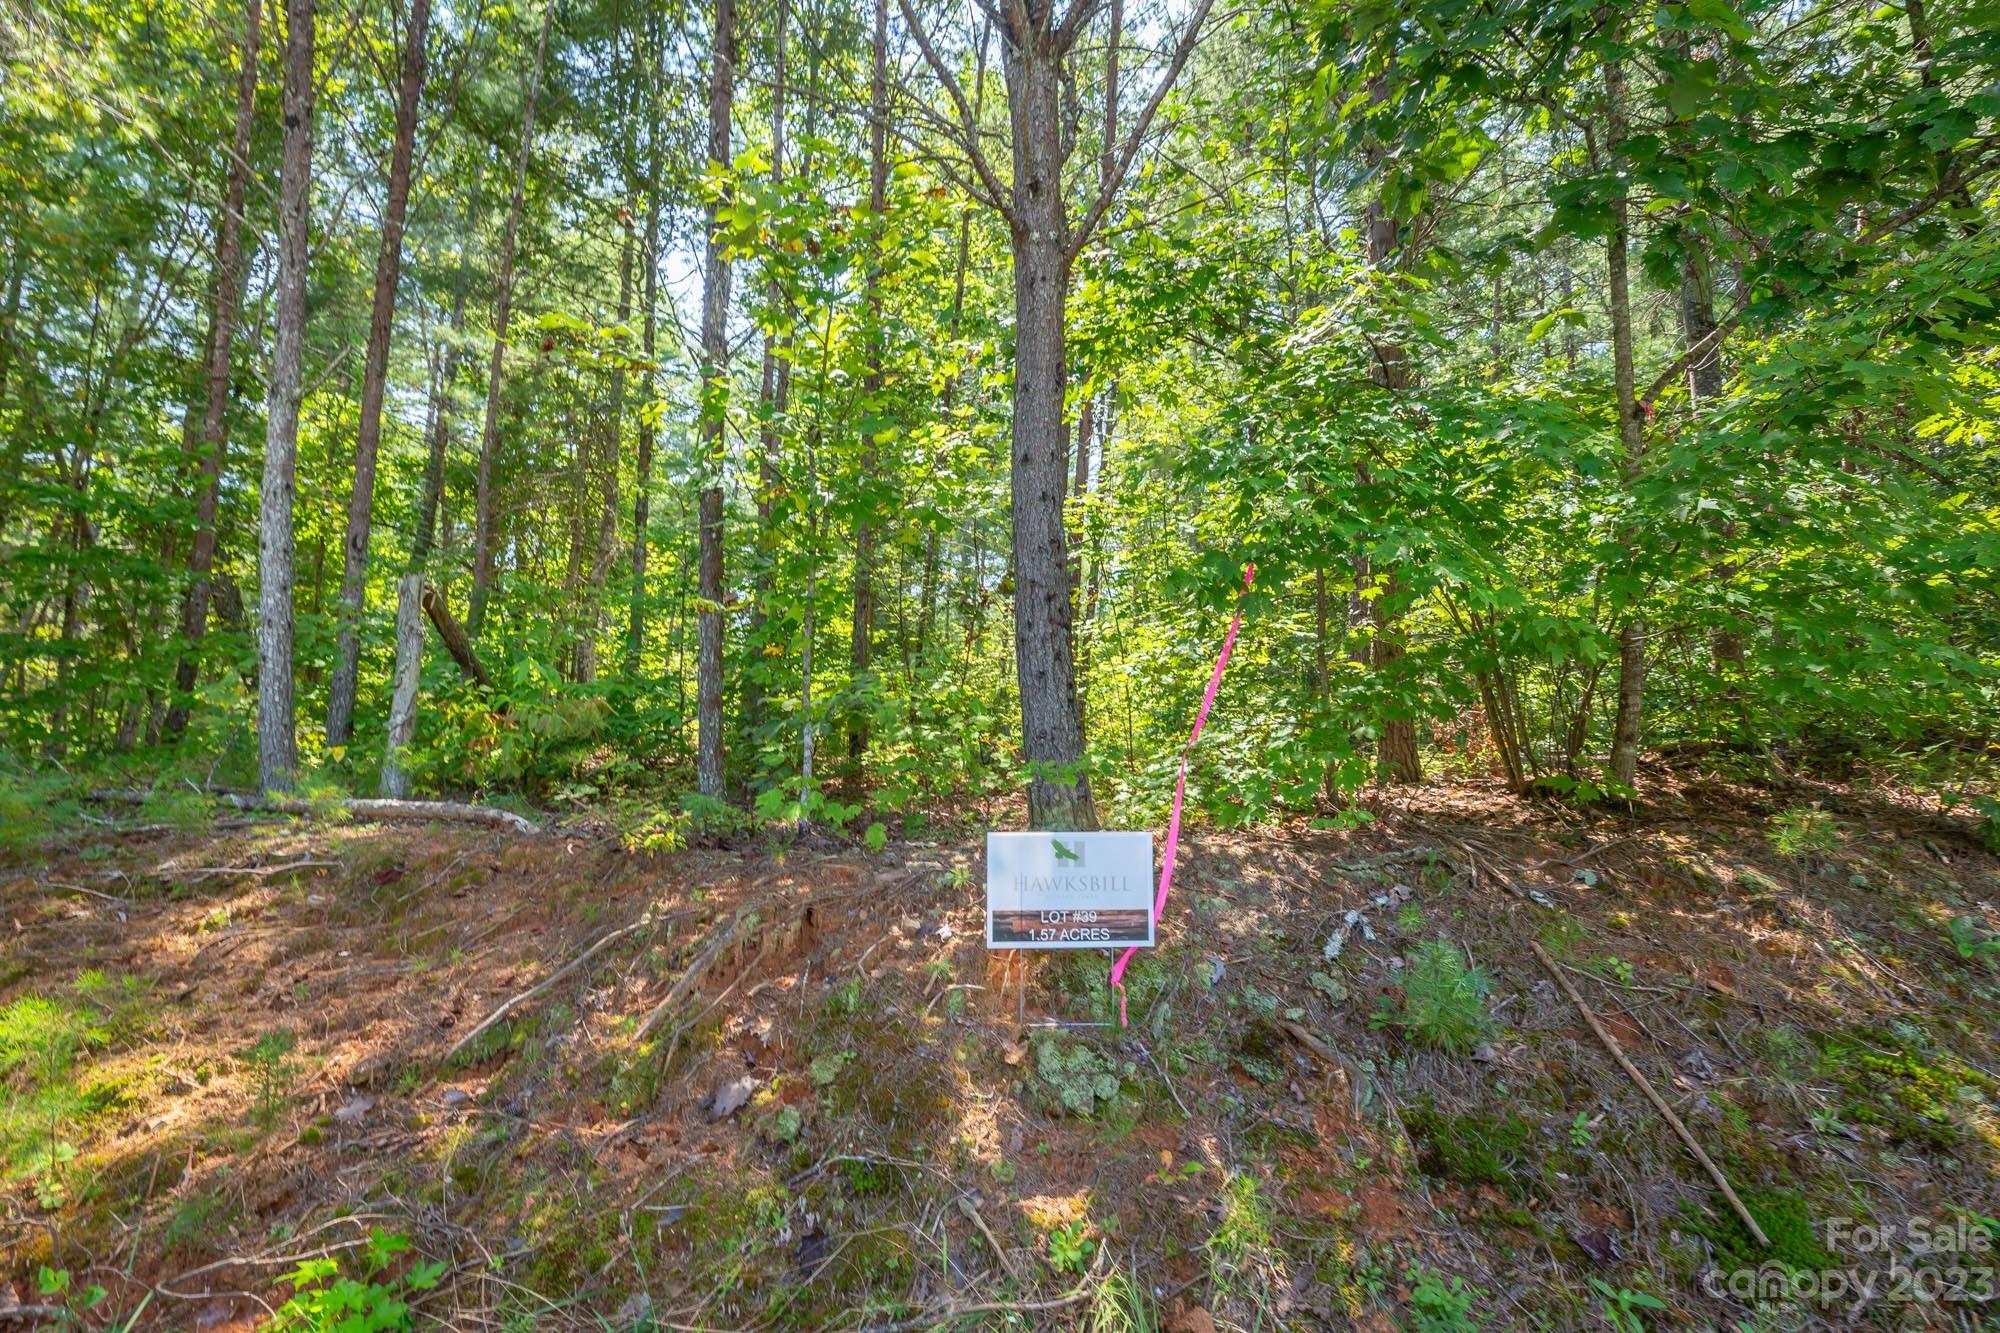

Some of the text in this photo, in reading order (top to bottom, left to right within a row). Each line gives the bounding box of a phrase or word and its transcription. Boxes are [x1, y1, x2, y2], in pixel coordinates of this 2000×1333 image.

[1014, 875, 1132, 892] HAWKSBILL
[1040, 911, 1097, 923] LOT #39
[1029, 928, 1110, 941] 1.57 ACRES
